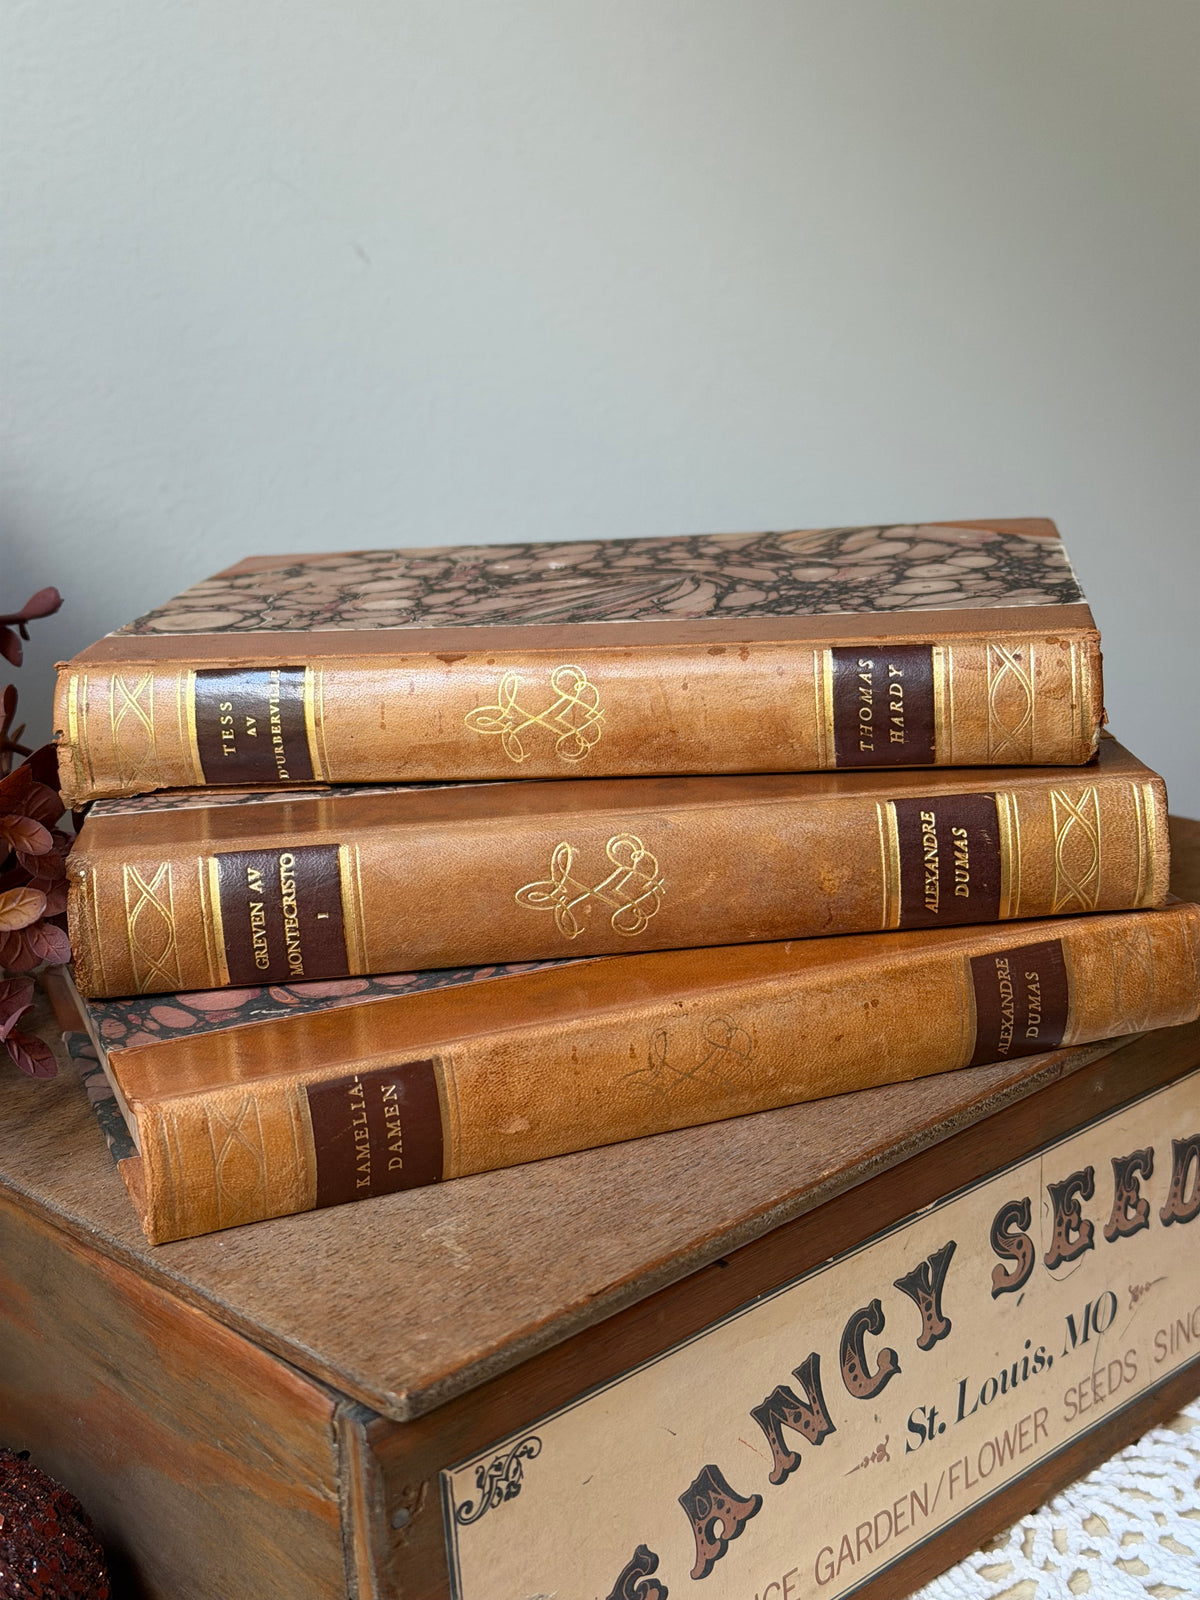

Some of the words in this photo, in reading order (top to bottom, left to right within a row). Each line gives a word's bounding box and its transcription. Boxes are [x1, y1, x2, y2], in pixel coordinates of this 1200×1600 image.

[220, 701, 236, 756] TESS
[246, 716, 257, 737] AV
[269, 669, 290, 779] D'URBERVILLE
[858, 658, 874, 752] THOMAS
[888, 663, 905, 744] HARDY
[247, 867, 264, 894] AV
[920, 810, 939, 914] ALEXANDRE
[951, 827, 970, 898] DUMAS
[249, 902, 270, 970] GREVEN
[279, 852, 305, 976] MONTECRISTO
[995, 957, 1014, 1055] ALEXANDRE
[1025, 971, 1041, 1039] DUMAS
[348, 1075, 371, 1189] KAMELIA-
[381, 1084, 403, 1171] DAMEN
[990, 1133, 1200, 1300] SEED
[905, 1404, 947, 1454] St.
[954, 1339, 1054, 1424] Louis,
[1060, 1290, 1118, 1358] MO
[1063, 1348, 1138, 1423] SEEDS
